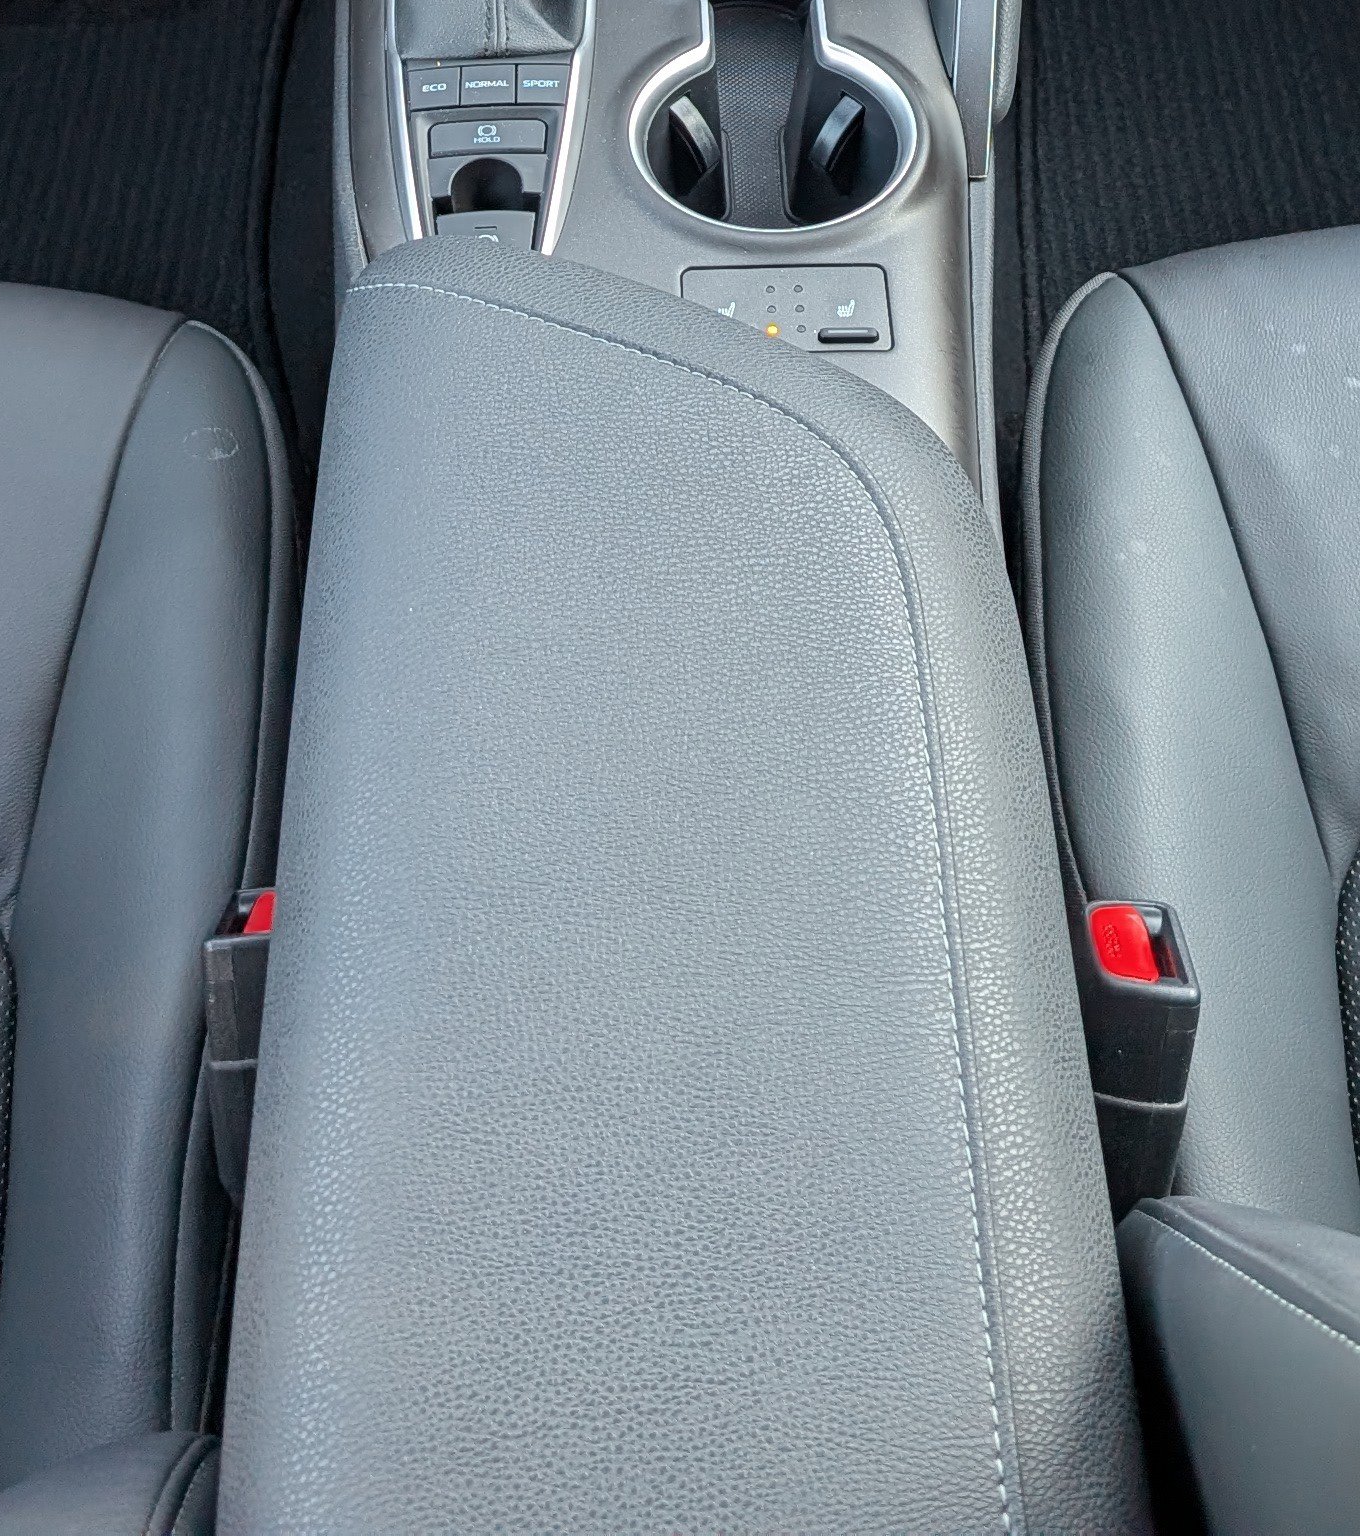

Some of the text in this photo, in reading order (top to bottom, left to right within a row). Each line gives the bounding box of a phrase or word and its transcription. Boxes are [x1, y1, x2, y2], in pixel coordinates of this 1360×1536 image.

[465, 79, 509, 89] NORMAL
[522, 80, 560, 88] SPORT
[473, 136, 501, 144] HOLD
